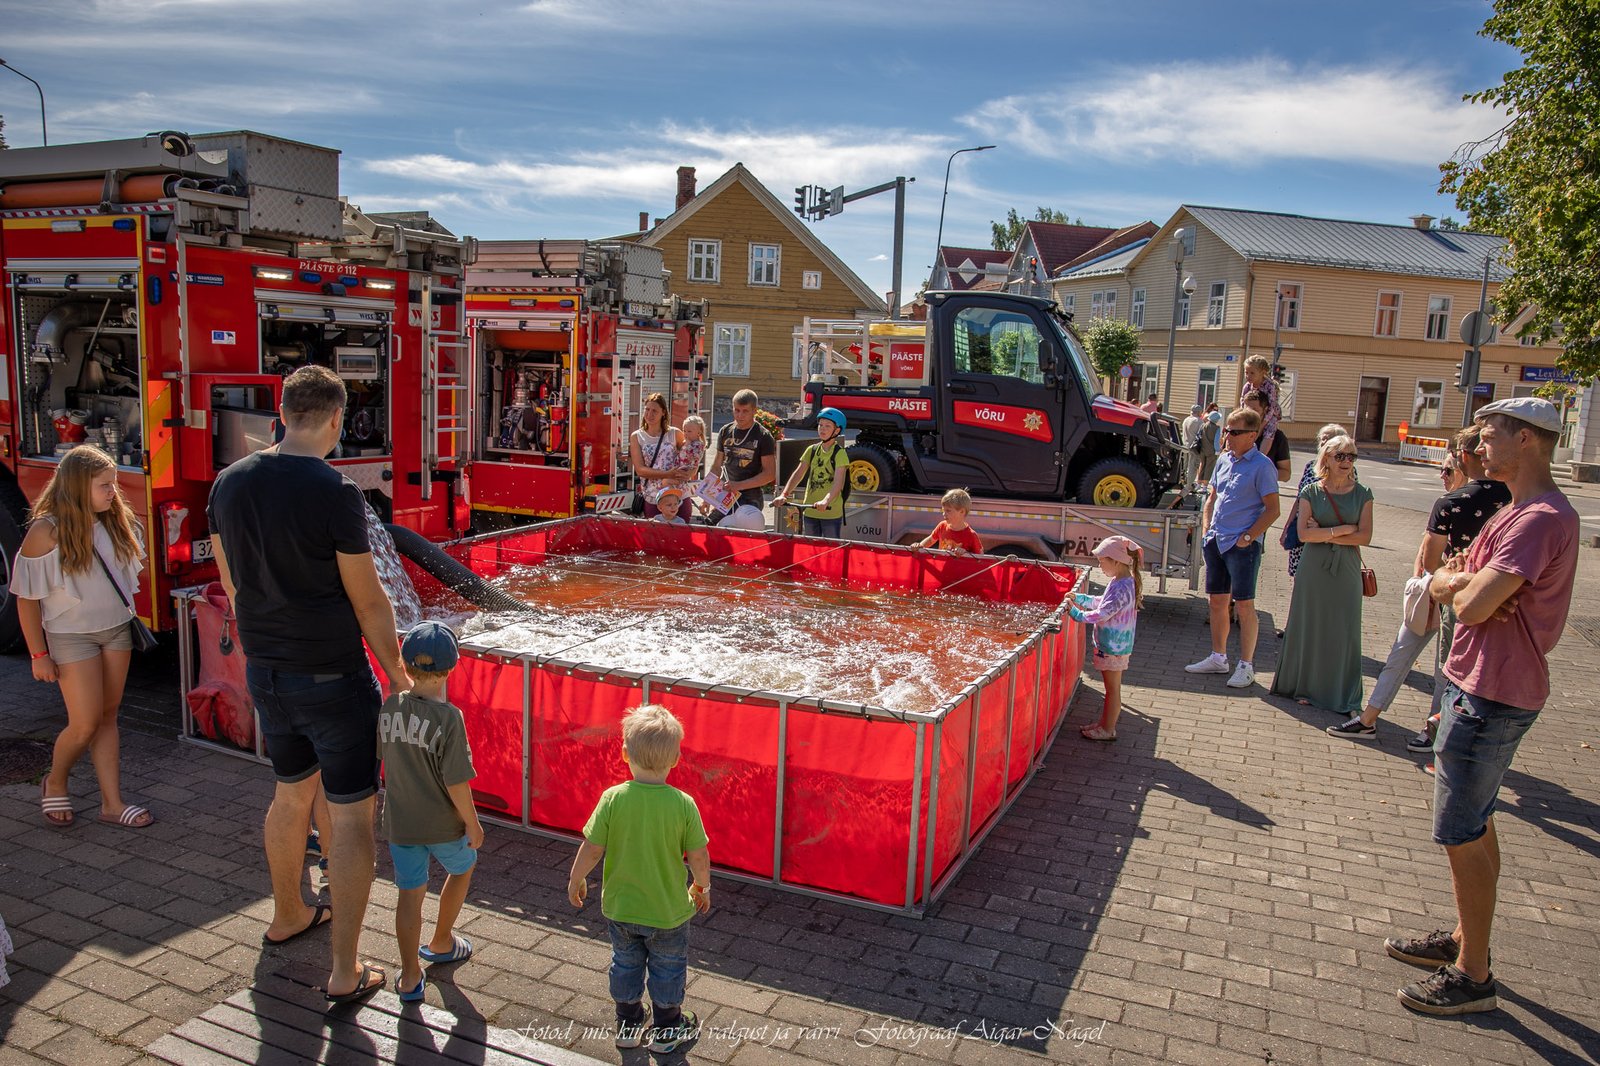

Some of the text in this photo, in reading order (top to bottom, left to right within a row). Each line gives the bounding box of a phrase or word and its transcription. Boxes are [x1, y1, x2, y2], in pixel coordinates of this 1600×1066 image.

[300, 261, 357, 275] PÄÄSTE 112
[891, 352, 923, 362] PÄÄSTE
[643, 364, 655, 379] 112
[888, 398, 928, 411] PÄÄSTE
[974, 408, 1006, 422] VÕRU
[856, 525, 881, 536] VÕRU
